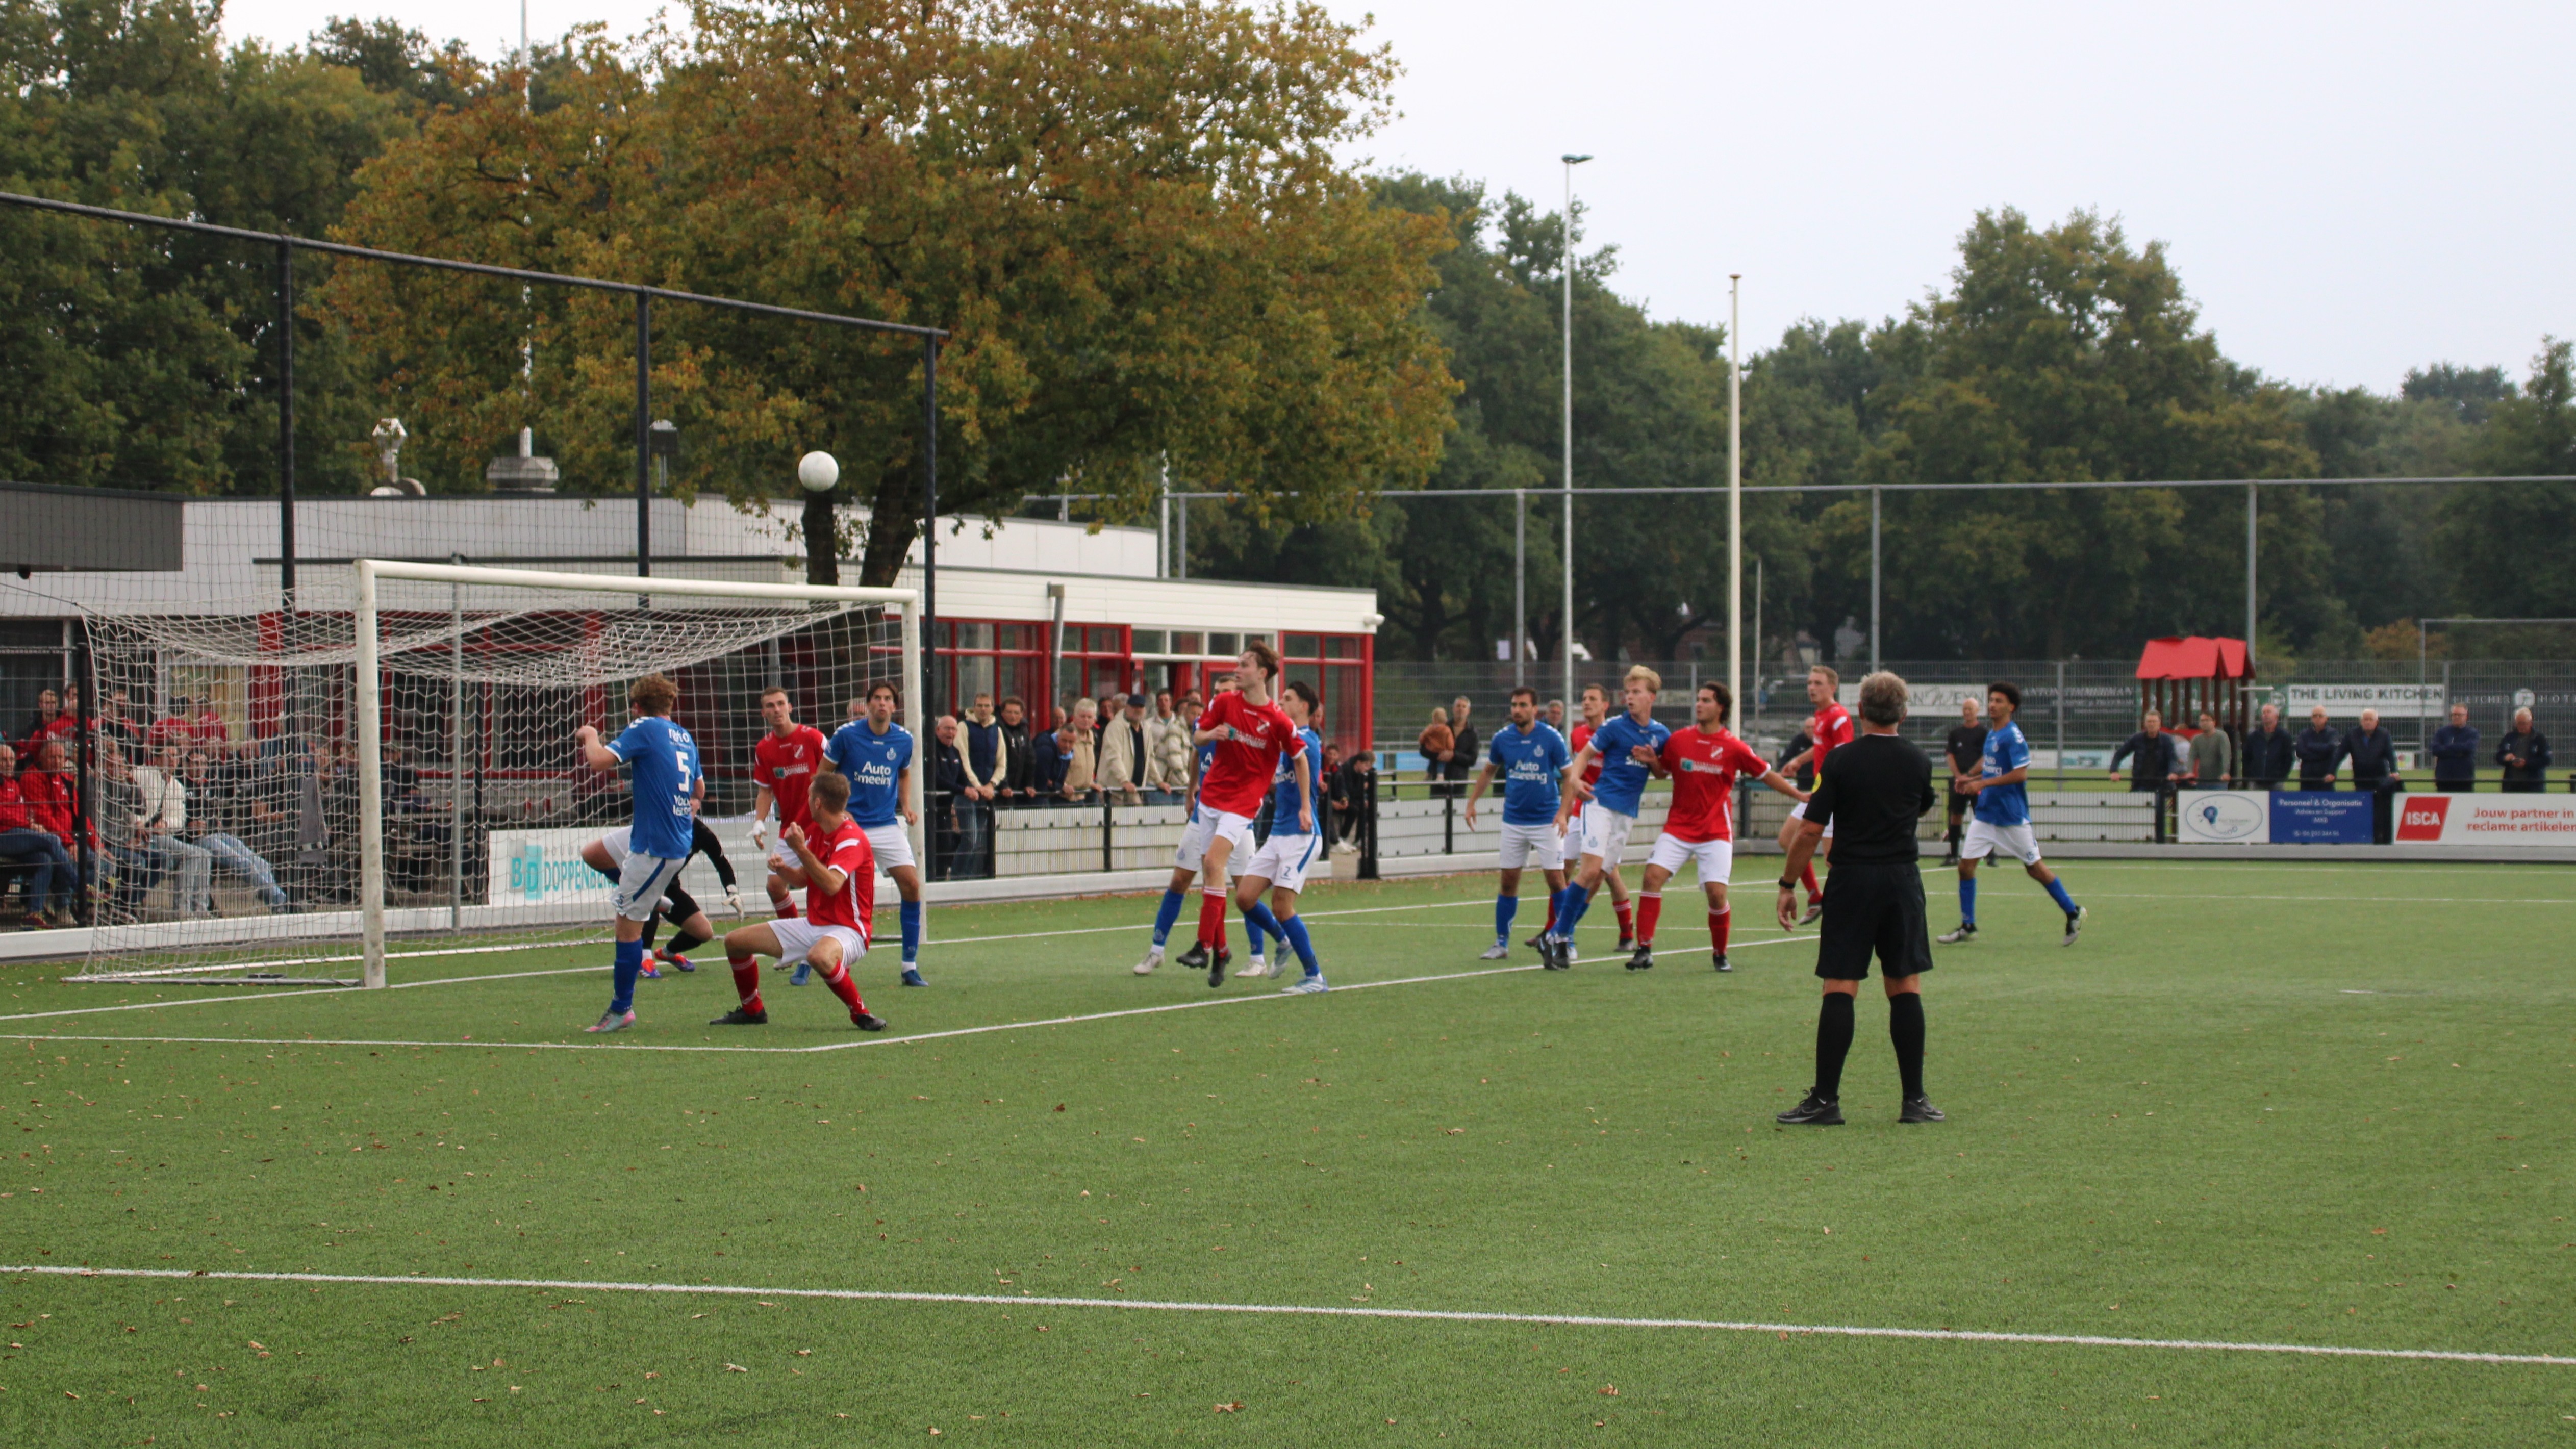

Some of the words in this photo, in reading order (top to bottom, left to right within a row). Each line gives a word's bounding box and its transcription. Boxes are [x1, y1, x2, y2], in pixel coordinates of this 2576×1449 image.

[2292, 689, 2319, 699] THE
[2325, 689, 2375, 700] LIVING
[2379, 689, 2443, 700] KITCHEN
[676, 751, 690, 792] 5
[862, 761, 891, 775] Auto
[1515, 759, 1540, 772] Auto
[2322, 799, 2363, 808] Organisatie
[2406, 811, 2441, 826] ISCA
[2474, 807, 2508, 818] Jouw
[2511, 808, 2559, 820] partner
[2563, 808, 2575, 818] in
[2467, 821, 2517, 832] reclame
[2520, 821, 2576, 832] artikelen
